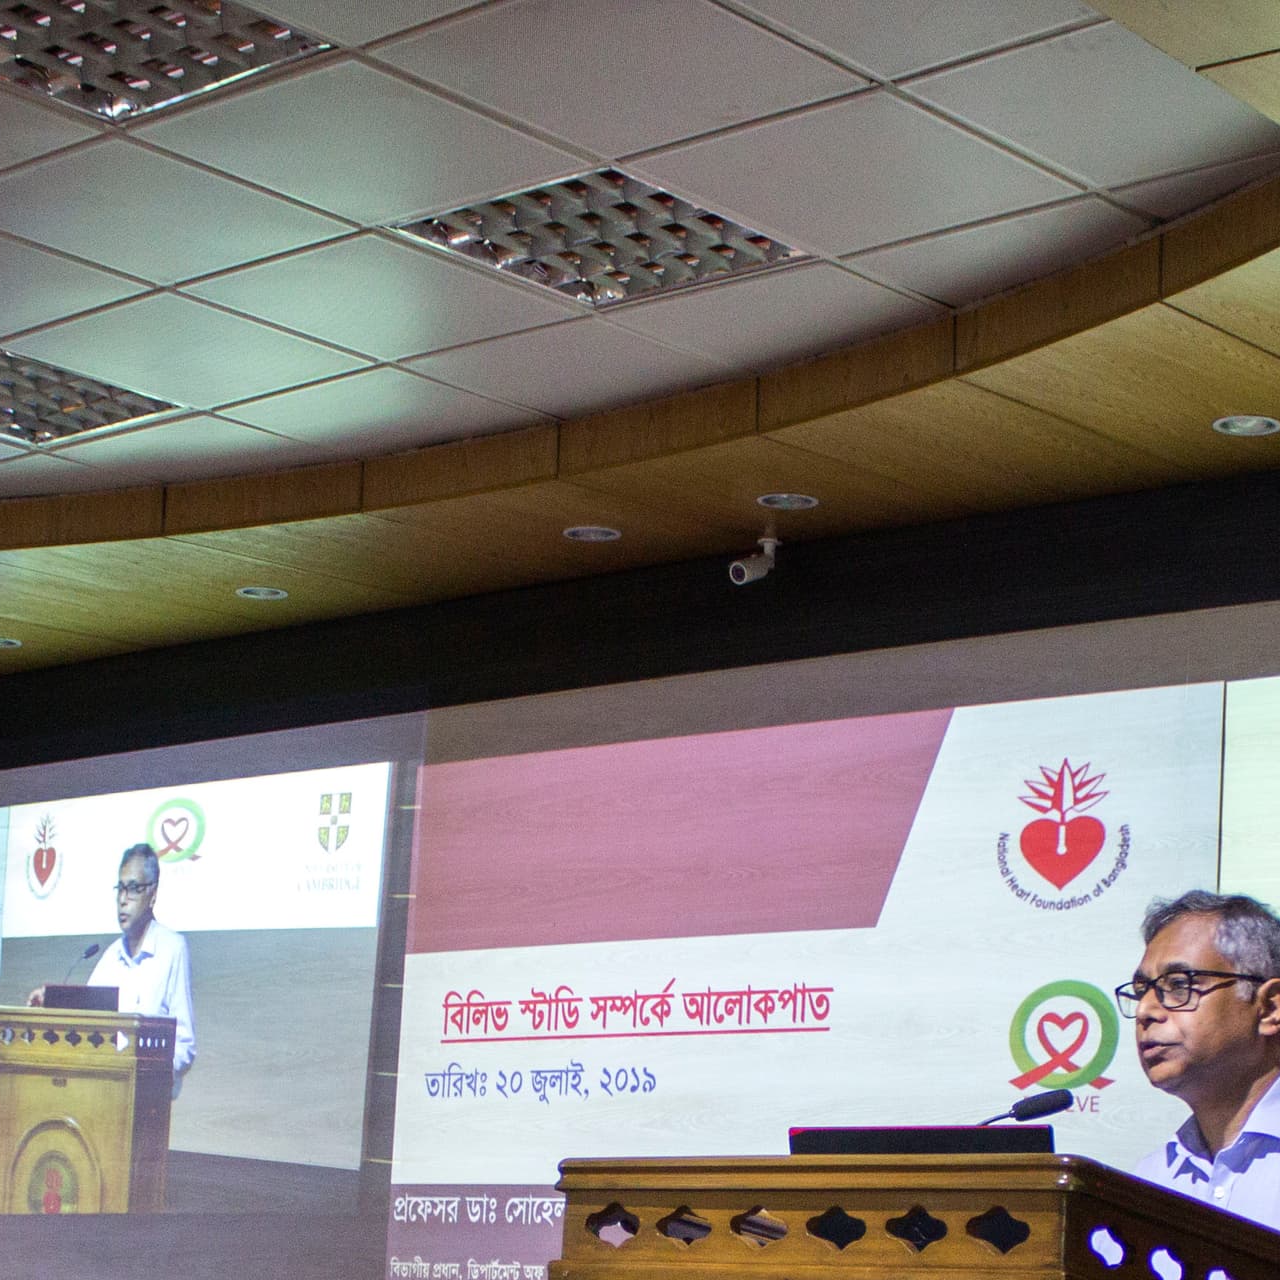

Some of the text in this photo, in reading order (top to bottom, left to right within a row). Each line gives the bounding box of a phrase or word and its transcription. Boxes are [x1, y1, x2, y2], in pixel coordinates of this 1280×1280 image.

[997, 824, 1130, 911] National Heart Foundation of Bangladesh
[442, 977, 834, 1035] বিলিভ স্টাডি সম্পর্কে আলোকপাত
[495, 1068, 523, 1095] ২০
[530, 1059, 590, 1104] জুলাই,
[599, 1065, 657, 1095] ২০১৯
[393, 1192, 461, 1223] প্রফেসর
